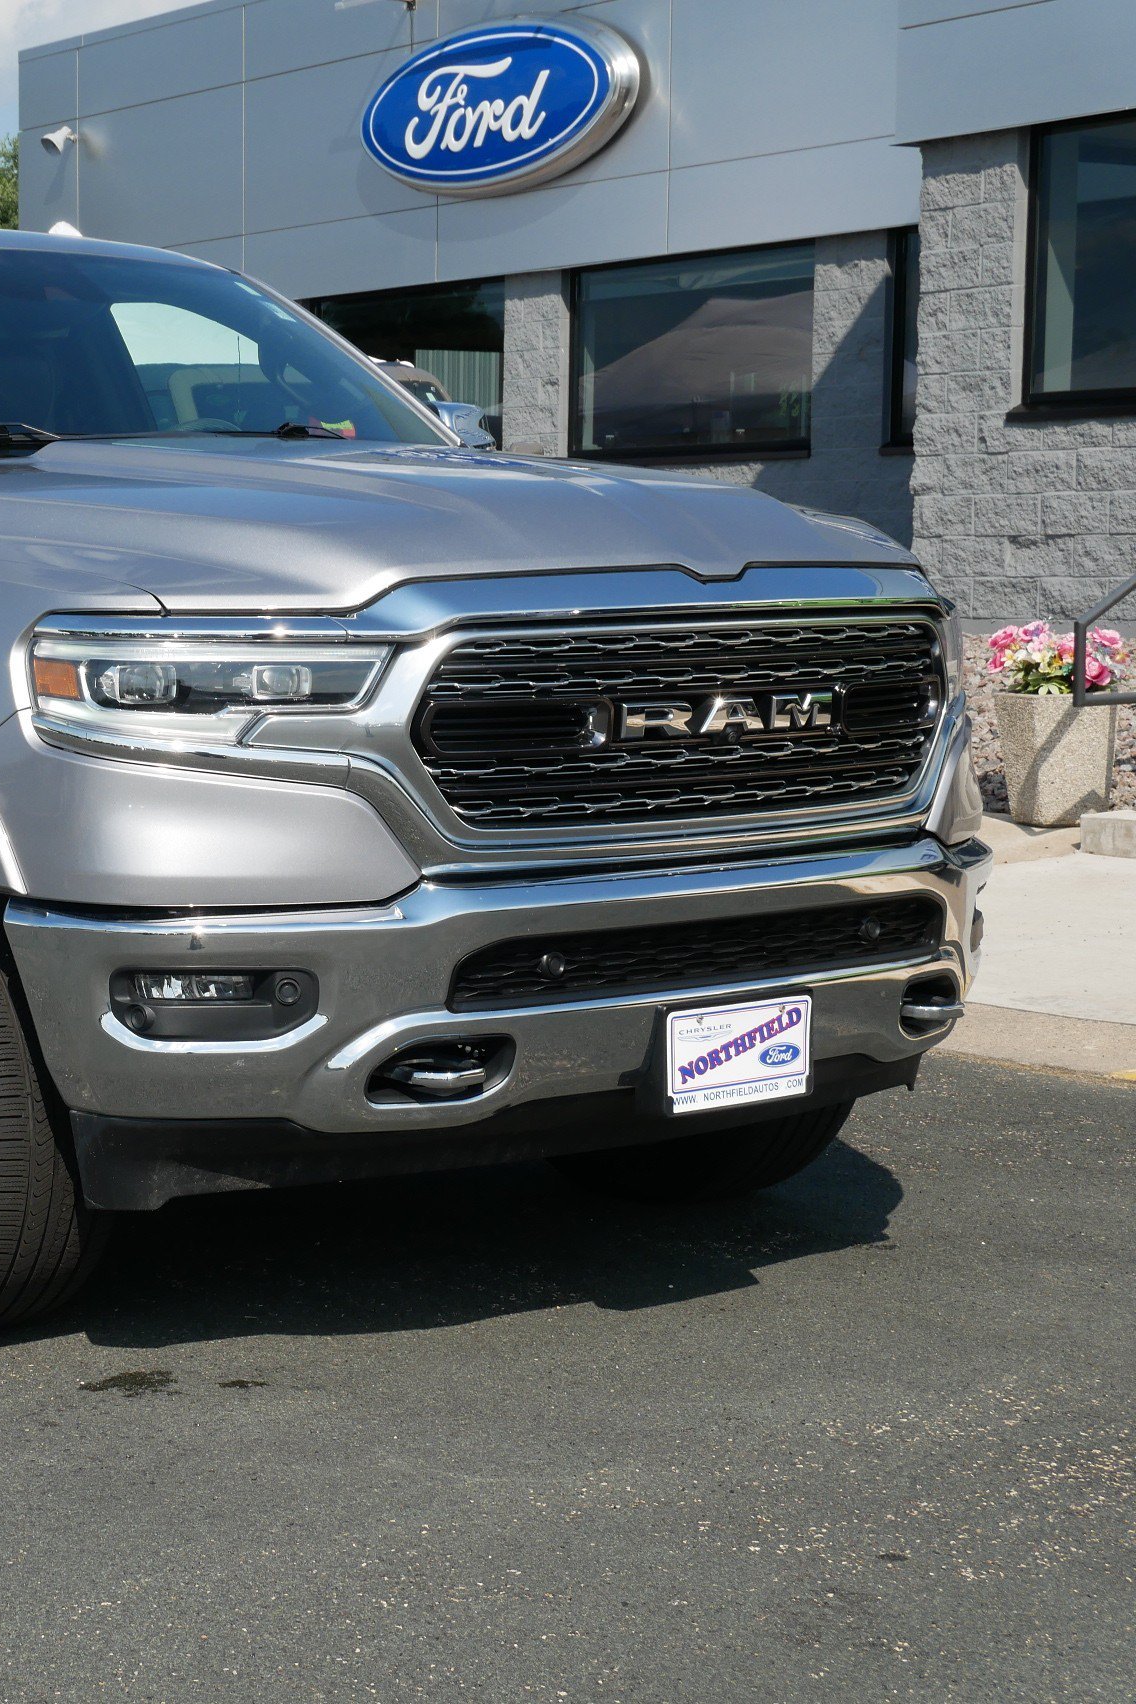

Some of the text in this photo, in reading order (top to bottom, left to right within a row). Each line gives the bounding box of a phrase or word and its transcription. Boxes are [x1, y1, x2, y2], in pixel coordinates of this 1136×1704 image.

[404, 56, 550, 160] Ford
[620, 692, 833, 739] RAM
[678, 1023, 732, 1036] CHRYSLER
[678, 1007, 802, 1085] NORTHFIELD
[766, 1045, 793, 1064] Ford
